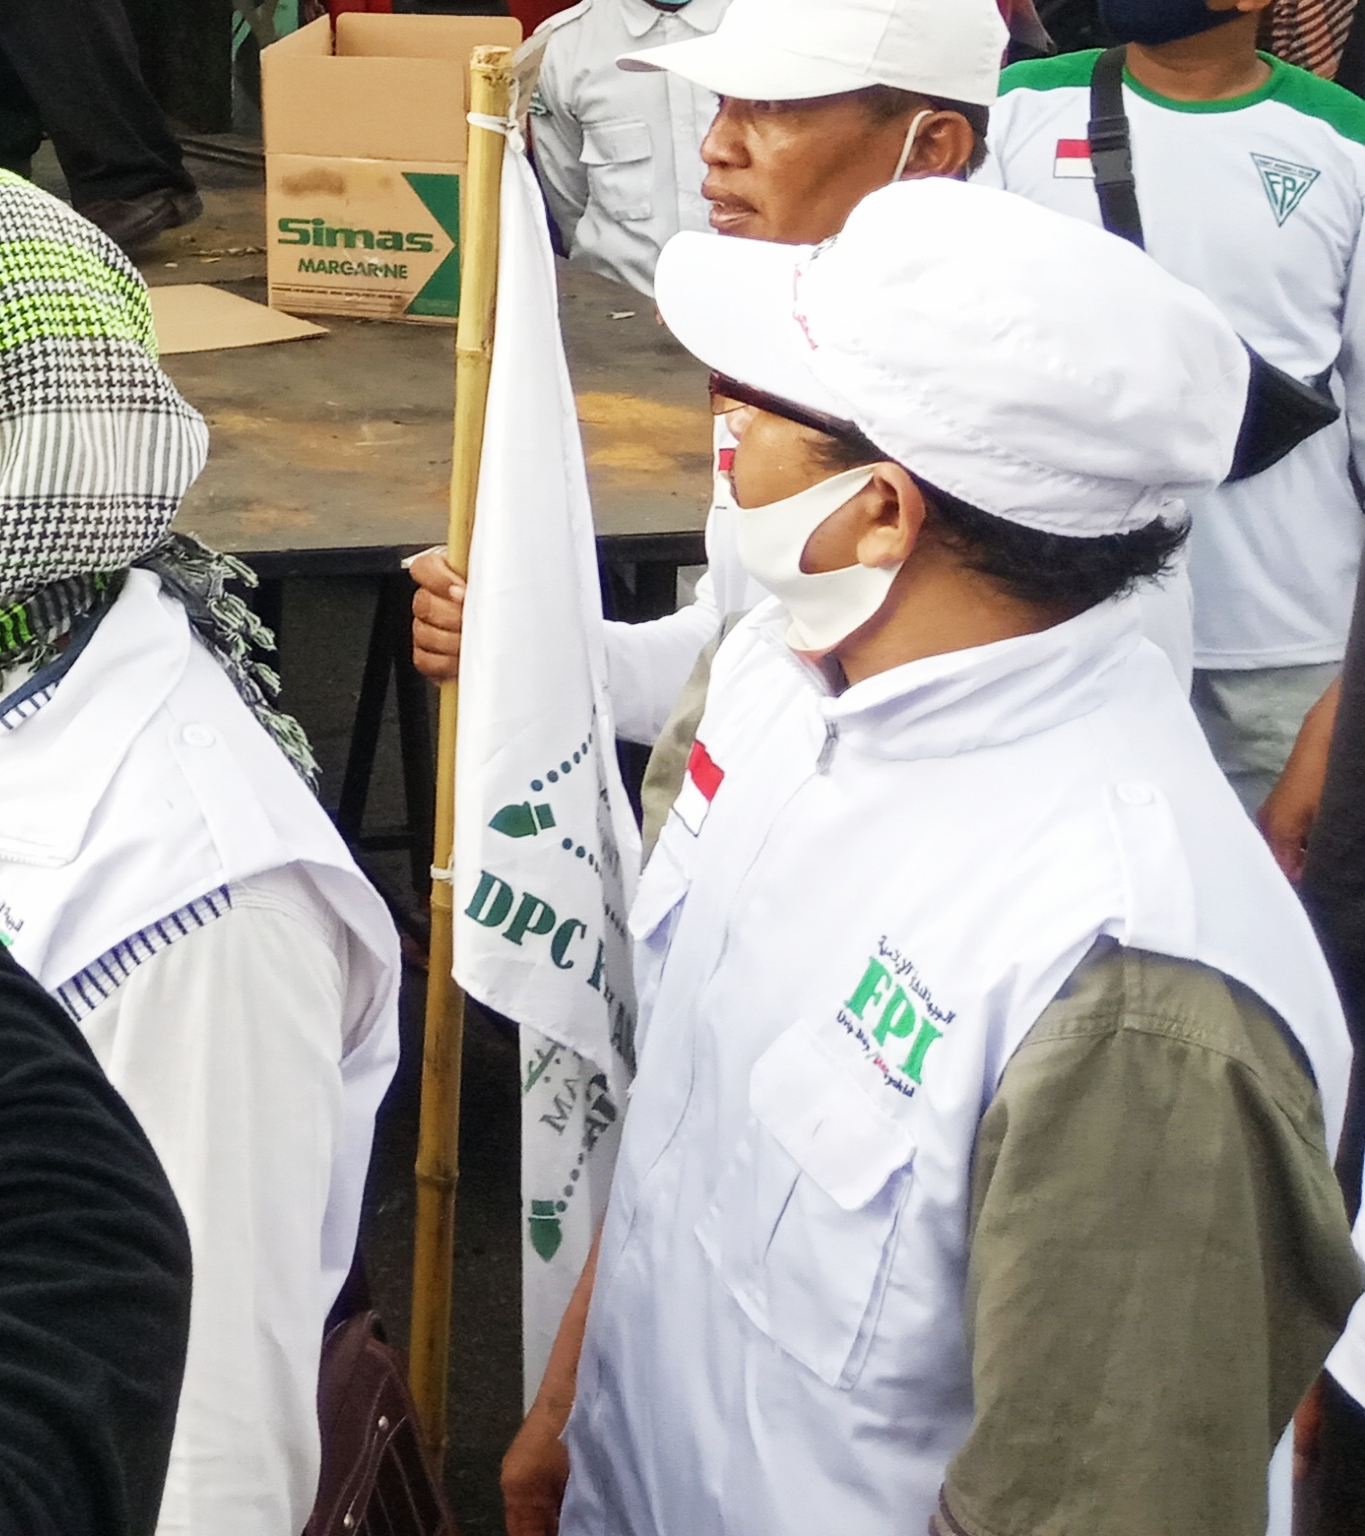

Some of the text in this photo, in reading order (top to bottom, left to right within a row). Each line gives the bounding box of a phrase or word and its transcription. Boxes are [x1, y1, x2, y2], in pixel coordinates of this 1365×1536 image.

[278, 217, 434, 253] Simas
[464, 869, 587, 971] DPC
[843, 955, 944, 1086] FPI
